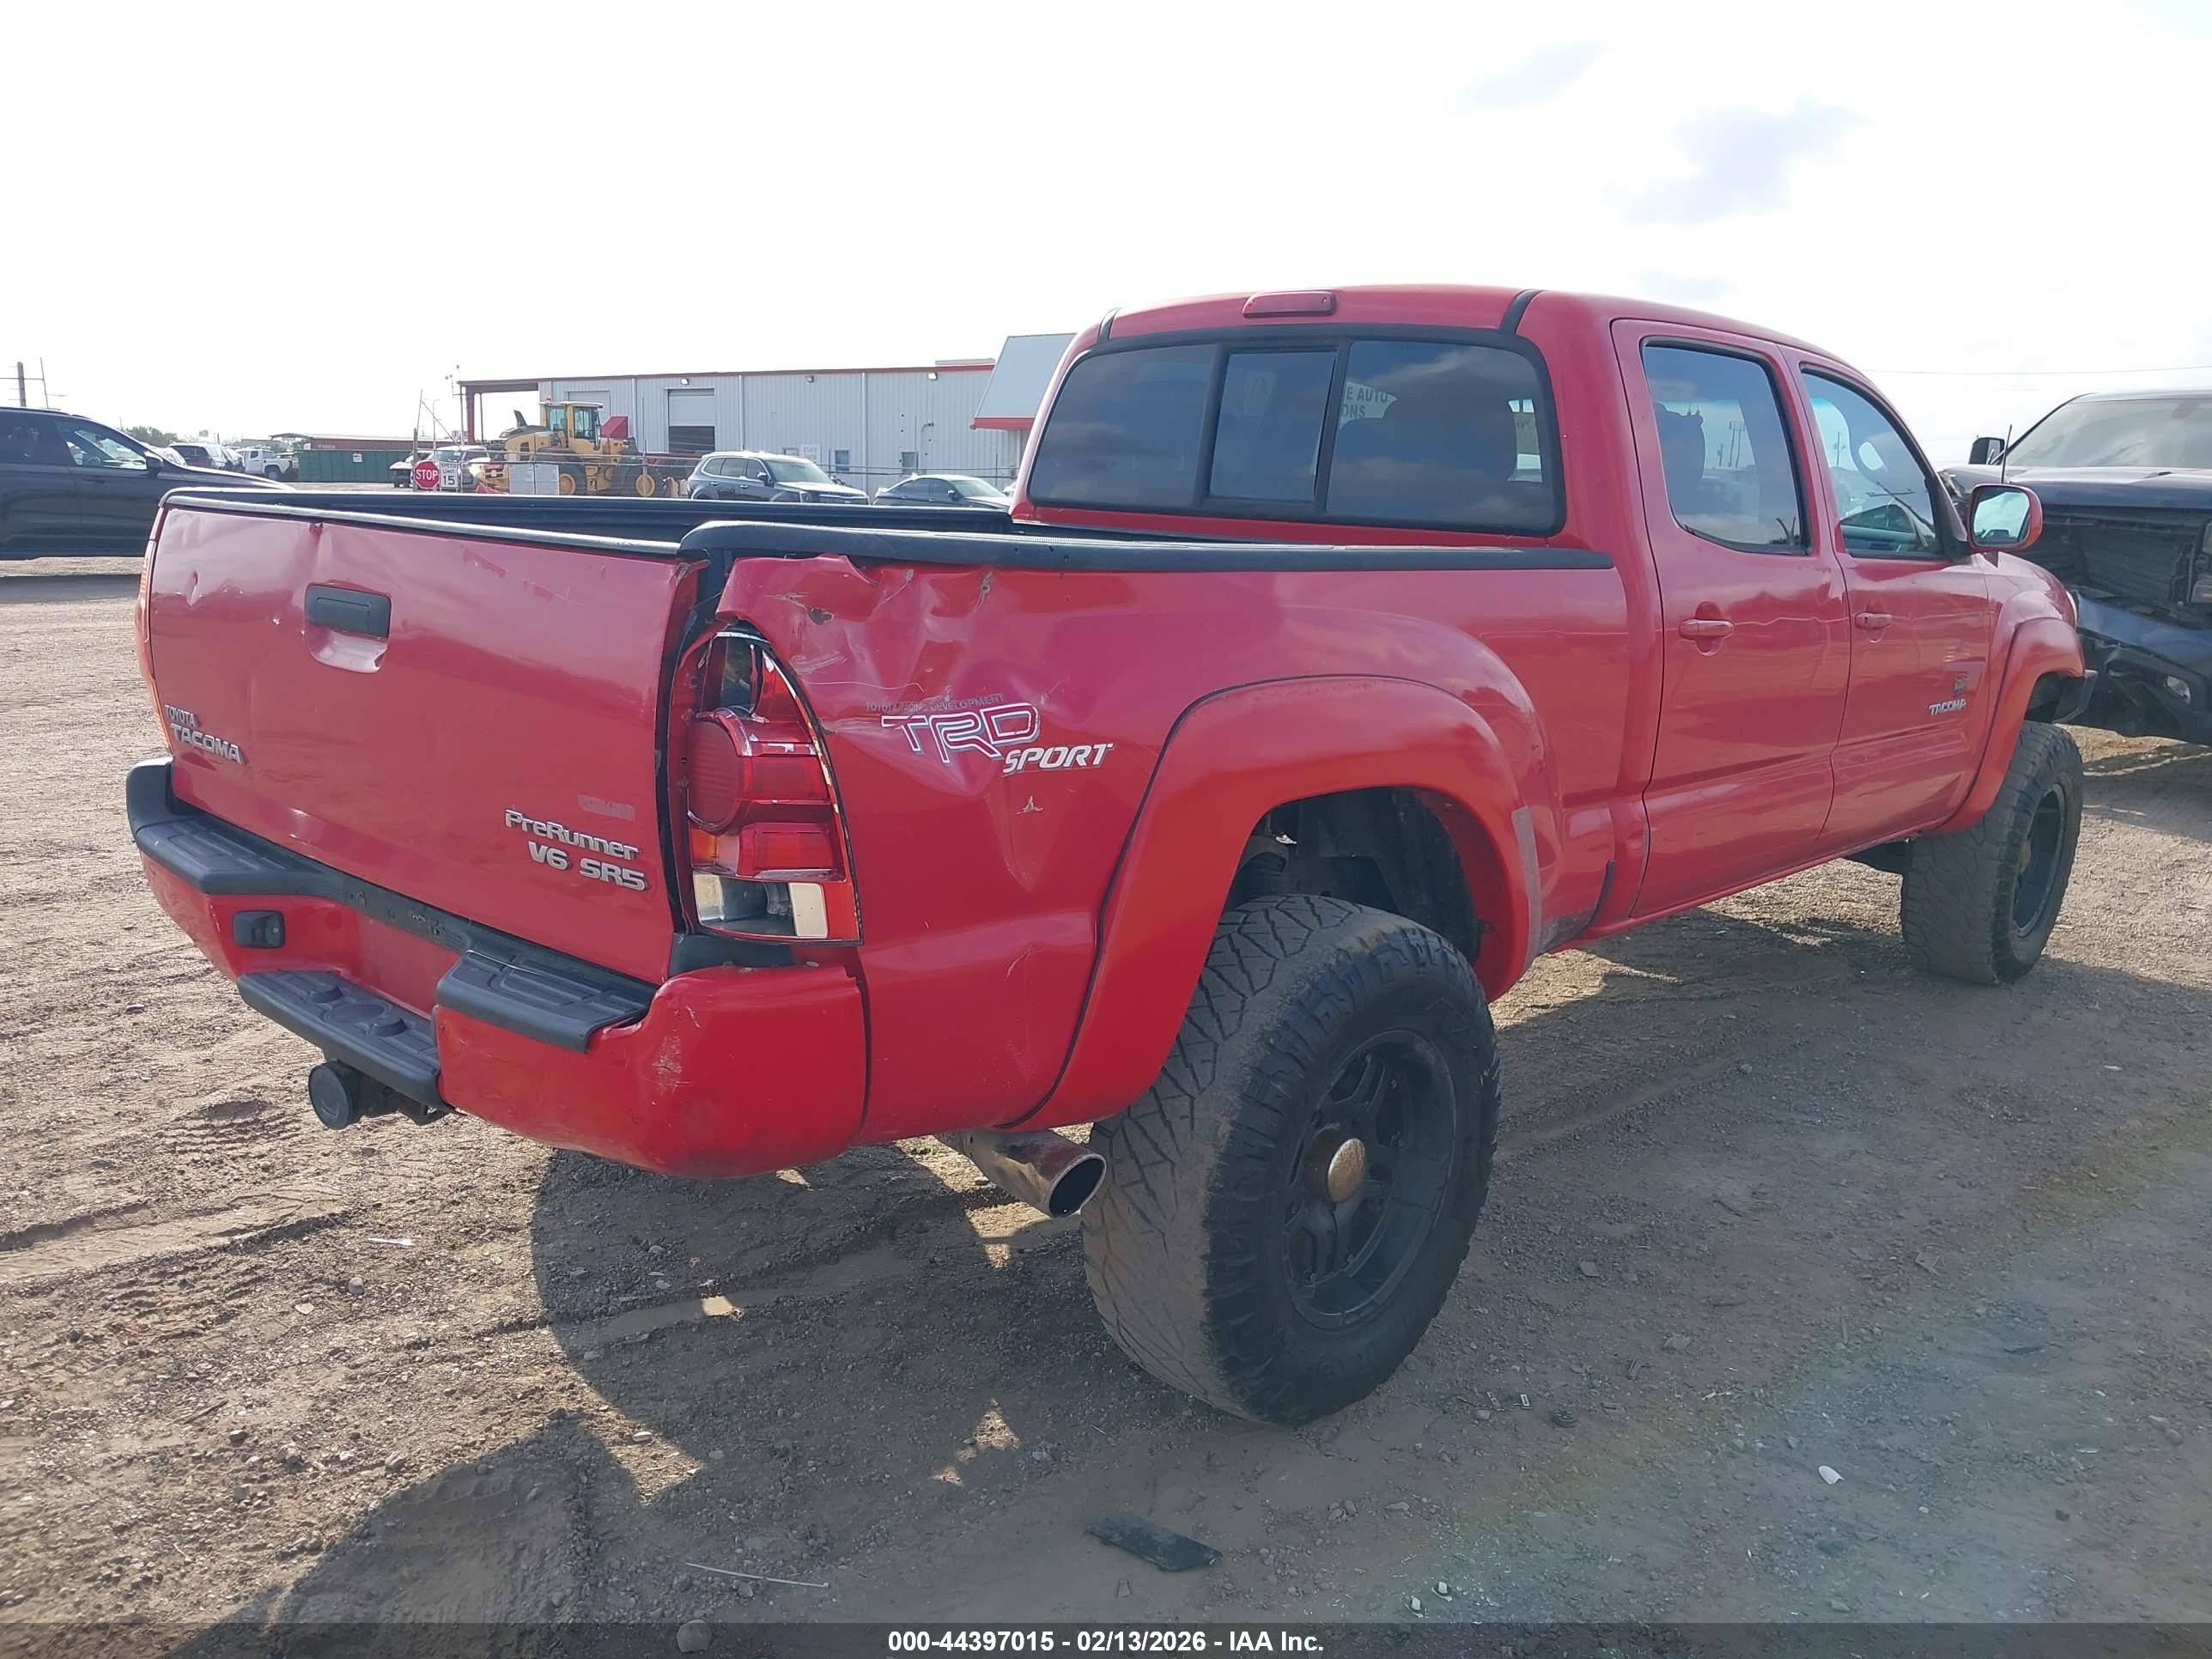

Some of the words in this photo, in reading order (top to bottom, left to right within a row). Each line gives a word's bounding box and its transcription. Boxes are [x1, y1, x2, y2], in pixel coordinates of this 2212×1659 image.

[416, 469, 439, 481] STOP
[443, 475, 455, 485] 15
[164, 704, 198, 729] TOYOTA
[1929, 698, 1966, 716] TACOMA
[170, 722, 243, 765] TACOMA
[881, 702, 1040, 763] TRD
[1003, 743, 1114, 773] SPORT
[505, 809, 641, 860] PreRunner
[528, 841, 569, 871] V6
[579, 858, 647, 891] SR5
